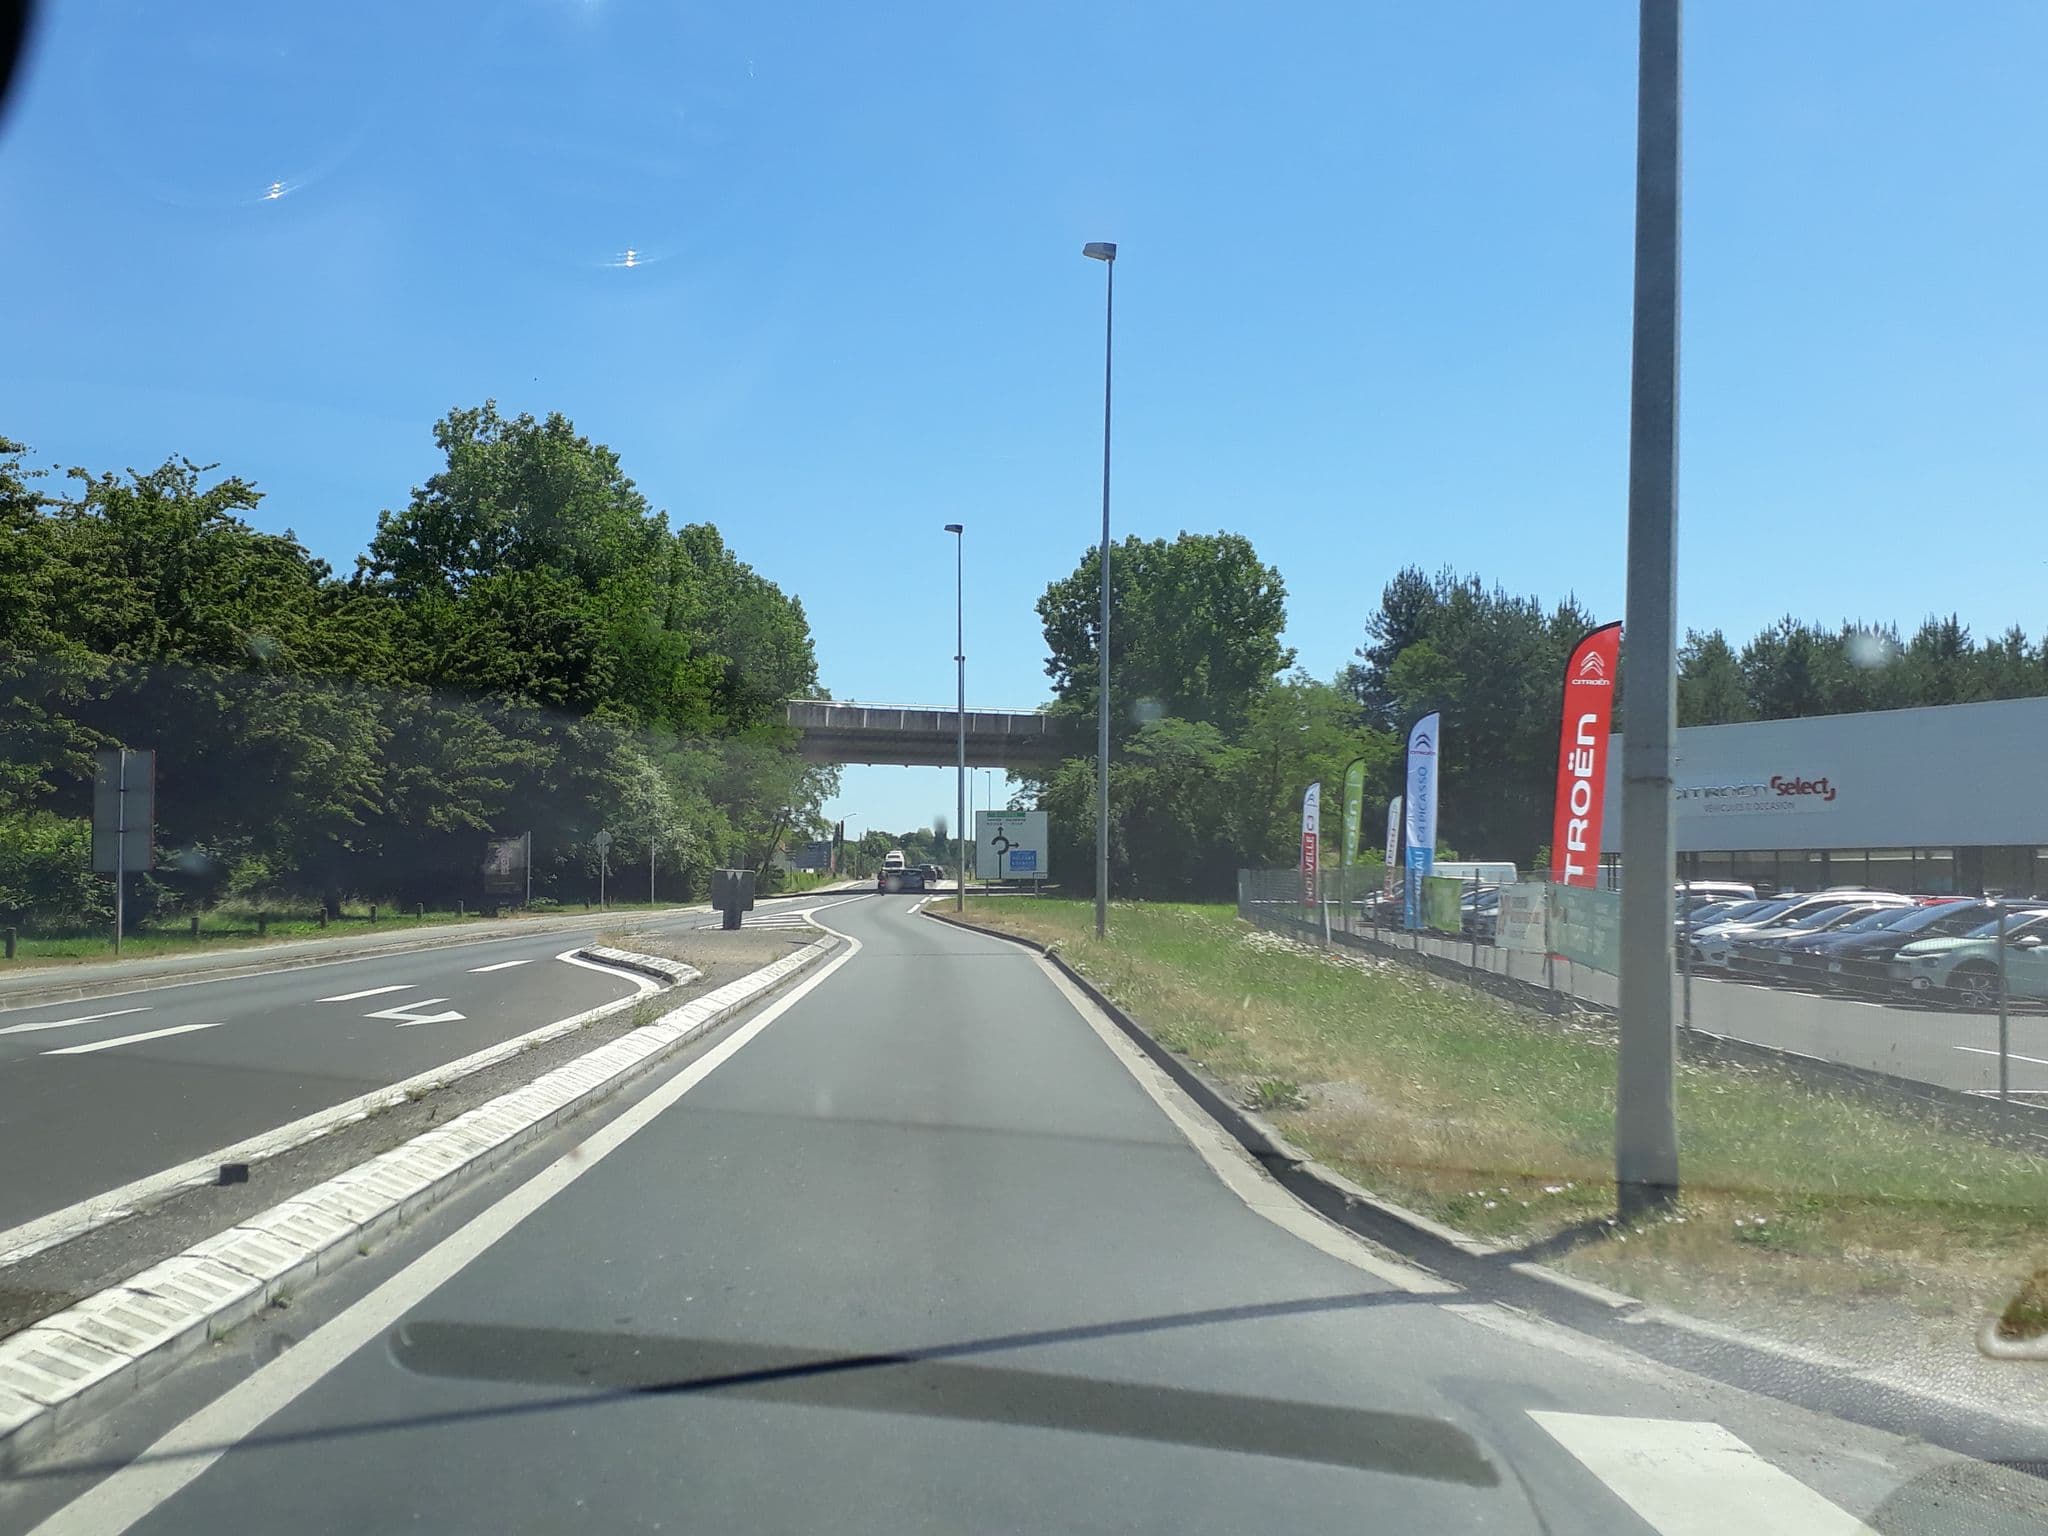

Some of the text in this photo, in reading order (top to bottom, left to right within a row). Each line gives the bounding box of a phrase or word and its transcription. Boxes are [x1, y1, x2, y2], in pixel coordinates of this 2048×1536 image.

[1418, 766, 1429, 823] PICASSO
[1564, 713, 1597, 886] TROËN
[1304, 836, 1315, 902] NOUVELLE
